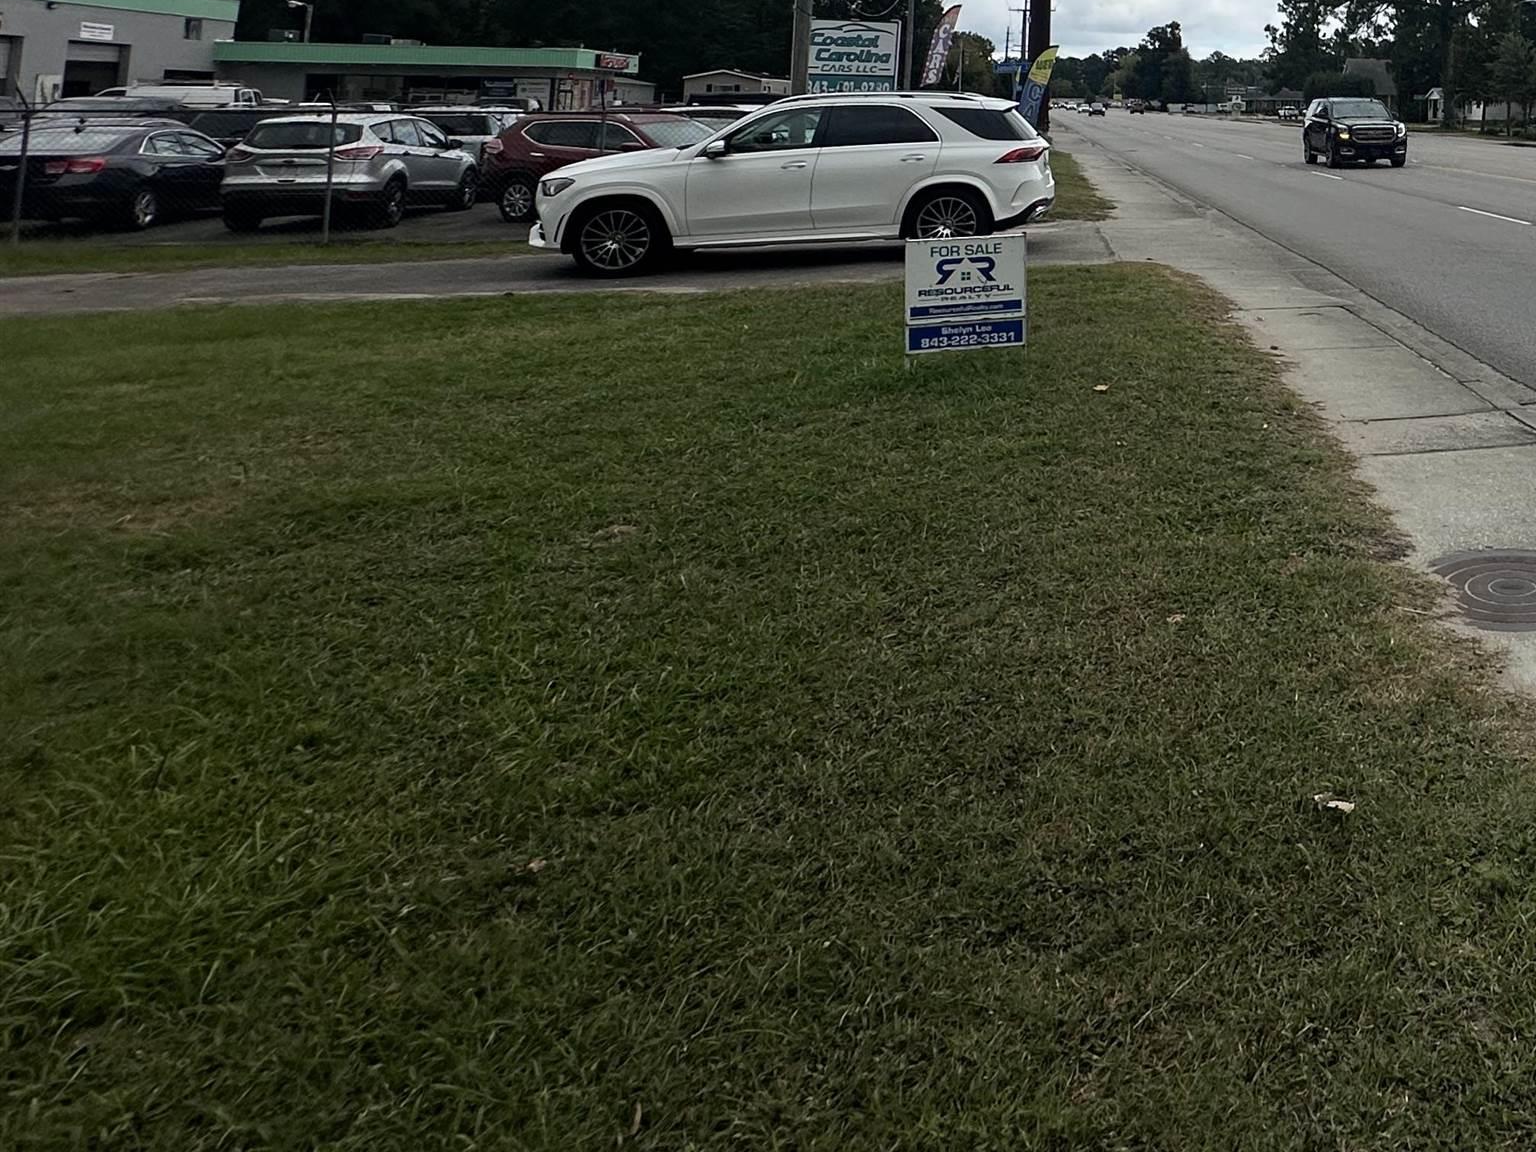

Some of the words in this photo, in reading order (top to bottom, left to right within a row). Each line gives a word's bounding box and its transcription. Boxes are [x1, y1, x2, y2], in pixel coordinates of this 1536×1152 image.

[810, 32, 880, 48] Coastal
[815, 48, 892, 63] Carolina
[925, 24, 951, 84] CARS
[820, 64, 853, 72] CARS
[855, 65, 878, 73] LLC
[930, 245, 961, 257] FOR
[964, 242, 1003, 256] SALE
[917, 284, 1014, 297] RESOURCEFUL
[940, 293, 992, 302] REALTY
[920, 331, 1015, 348] 843-222-3331
